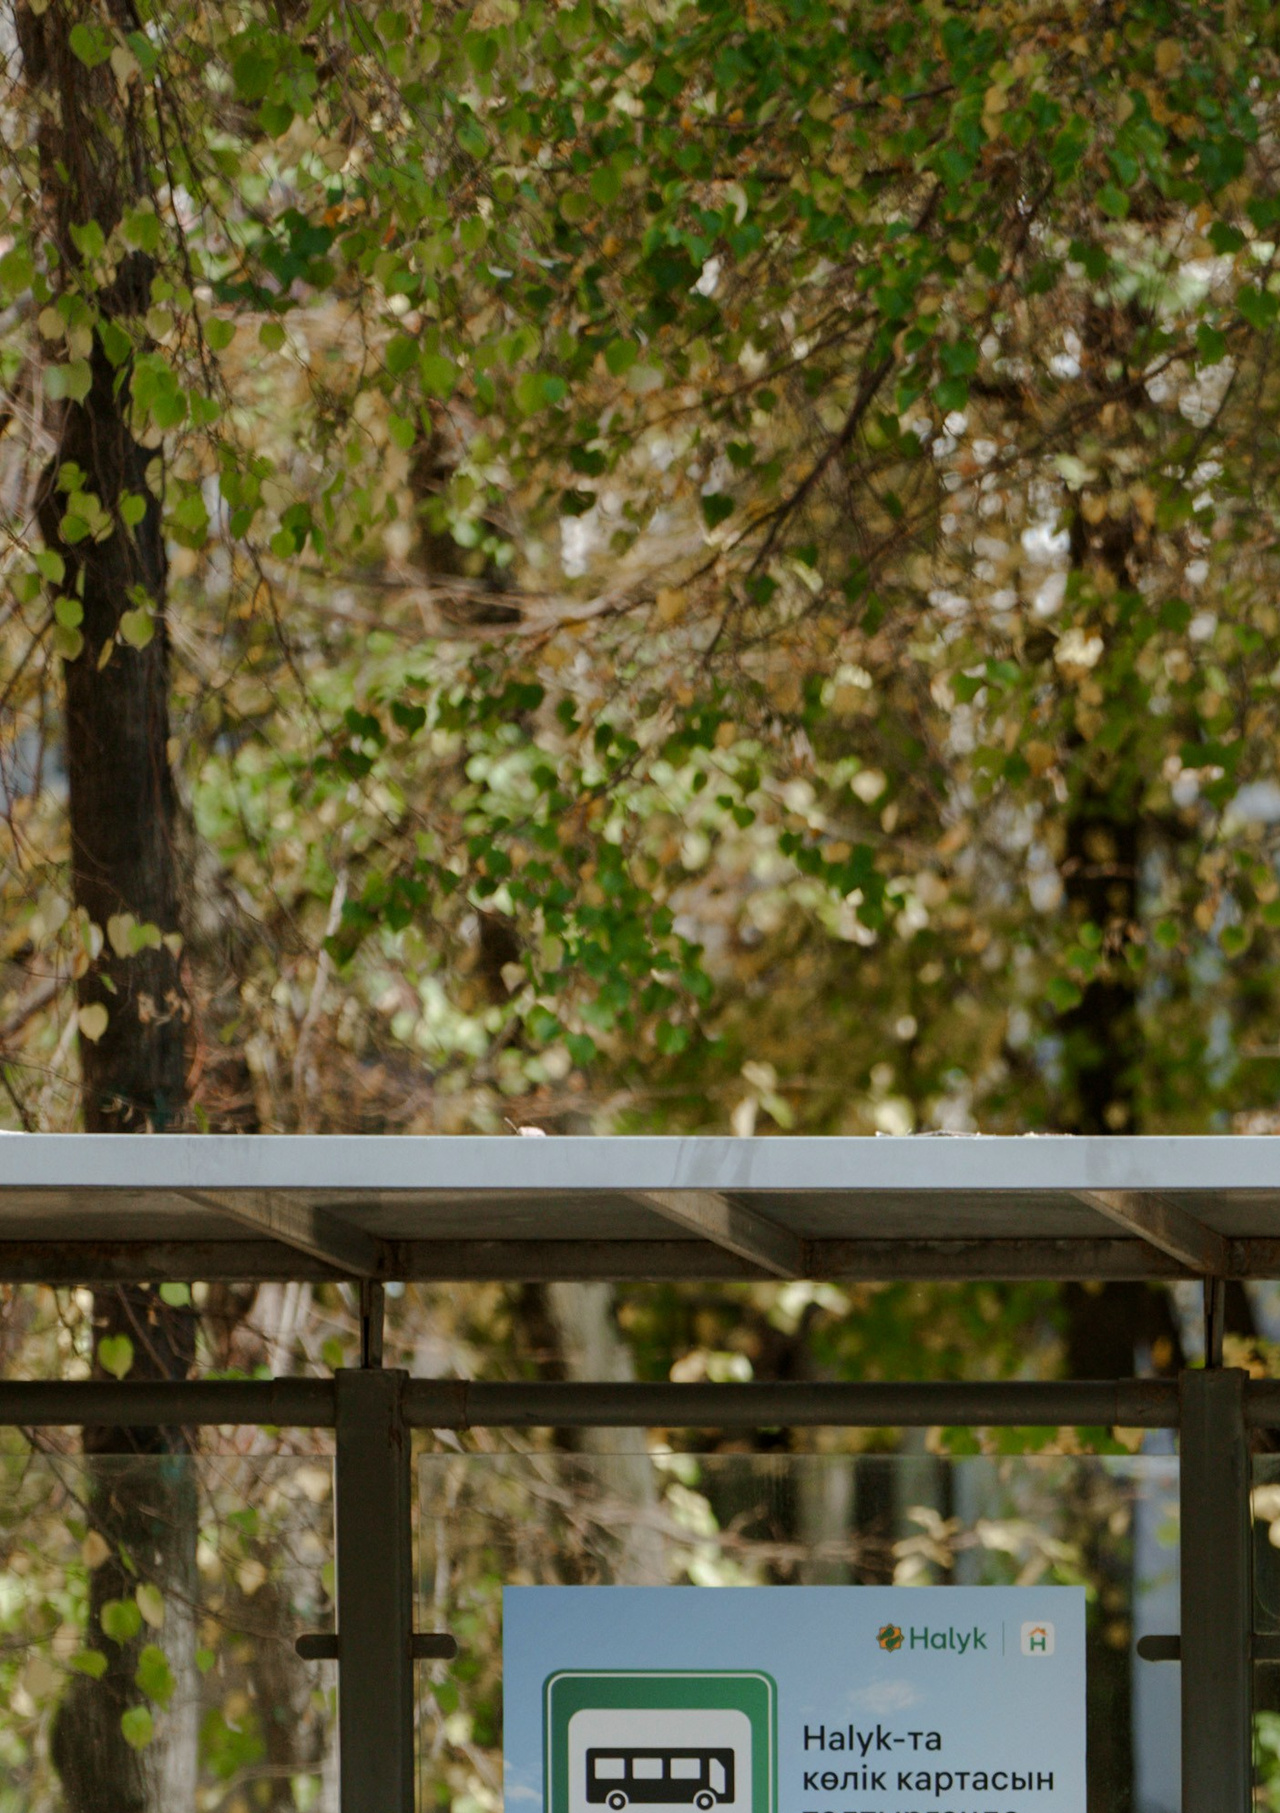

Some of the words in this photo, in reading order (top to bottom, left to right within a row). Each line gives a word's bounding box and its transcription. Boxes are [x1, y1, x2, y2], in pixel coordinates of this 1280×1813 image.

[909, 1626, 988, 1655] Halyk
[803, 1723, 942, 1758] Halyk-та
[803, 1763, 887, 1791] көлік
[897, 1771, 1054, 1798] картасын
